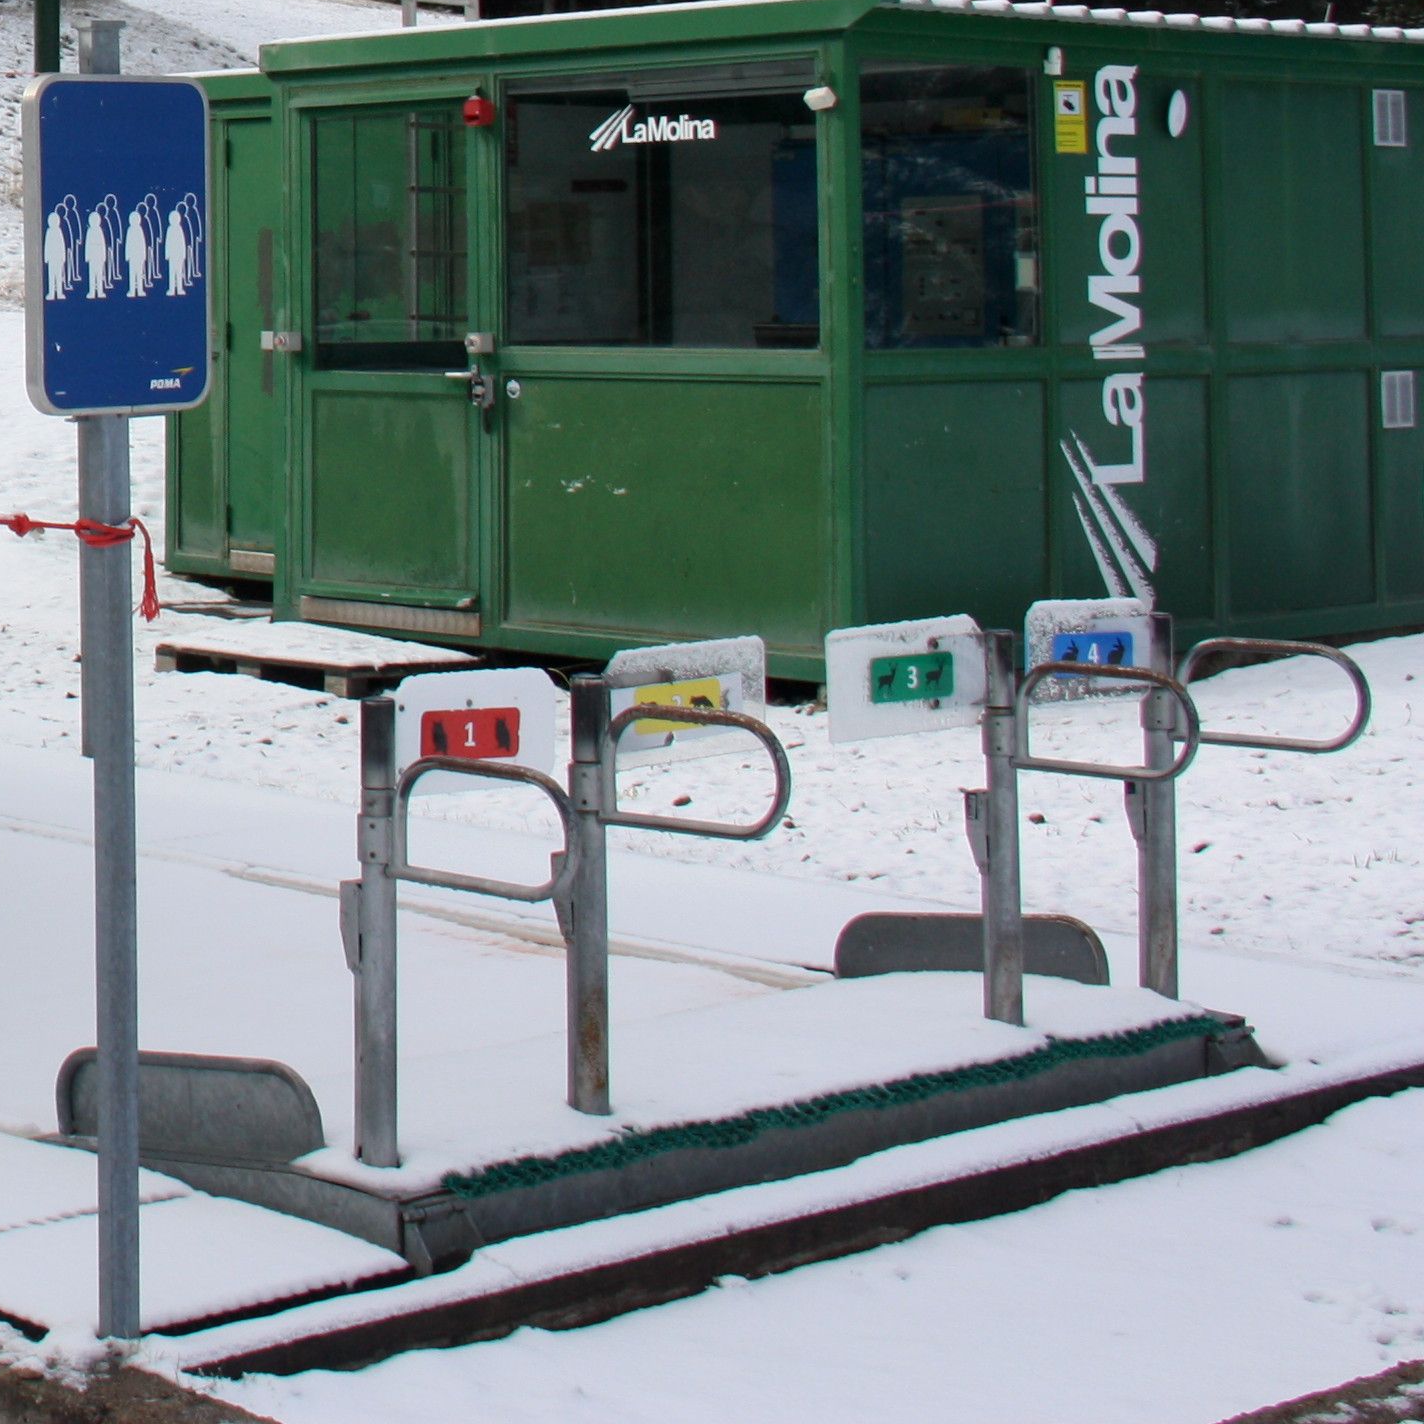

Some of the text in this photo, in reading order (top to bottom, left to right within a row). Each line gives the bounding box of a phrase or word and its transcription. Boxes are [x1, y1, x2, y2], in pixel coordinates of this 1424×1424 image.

[150, 378, 181, 389] POMA
[1087, 643, 1098, 663] 4
[907, 666, 920, 689] 3
[464, 722, 476, 747] 1
